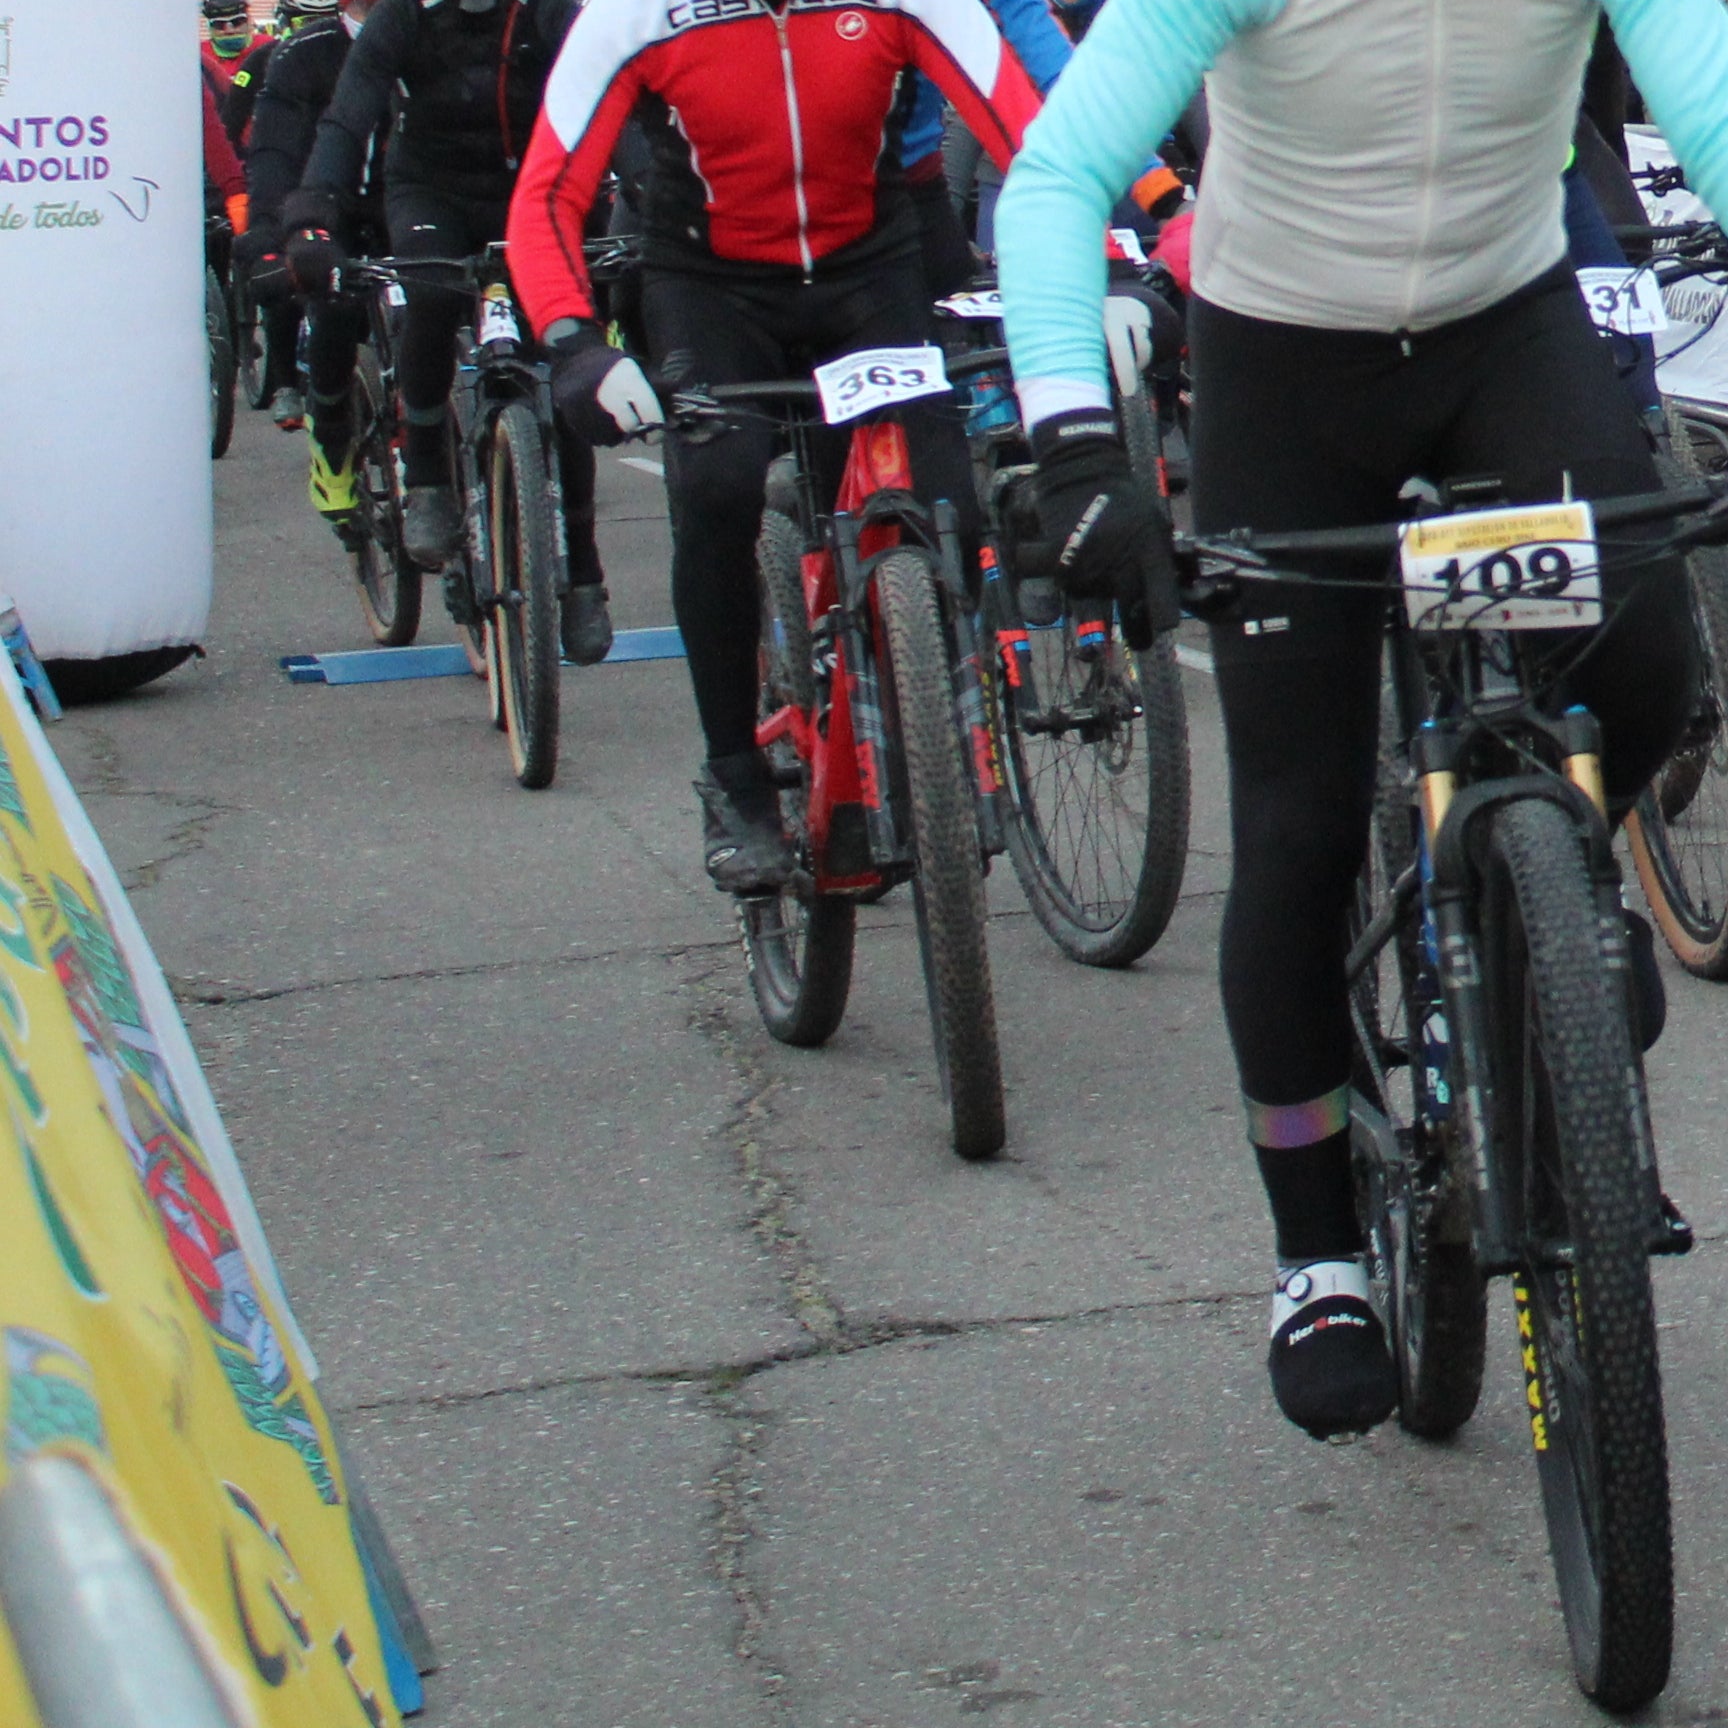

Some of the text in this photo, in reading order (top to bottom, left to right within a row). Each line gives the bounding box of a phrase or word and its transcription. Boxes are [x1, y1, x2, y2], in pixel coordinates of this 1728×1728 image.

[33, 200, 104, 230] todos
[837, 364, 926, 402] 363
[1433, 546, 1572, 604] 109
[1513, 1271, 1549, 1451] MAXXI
